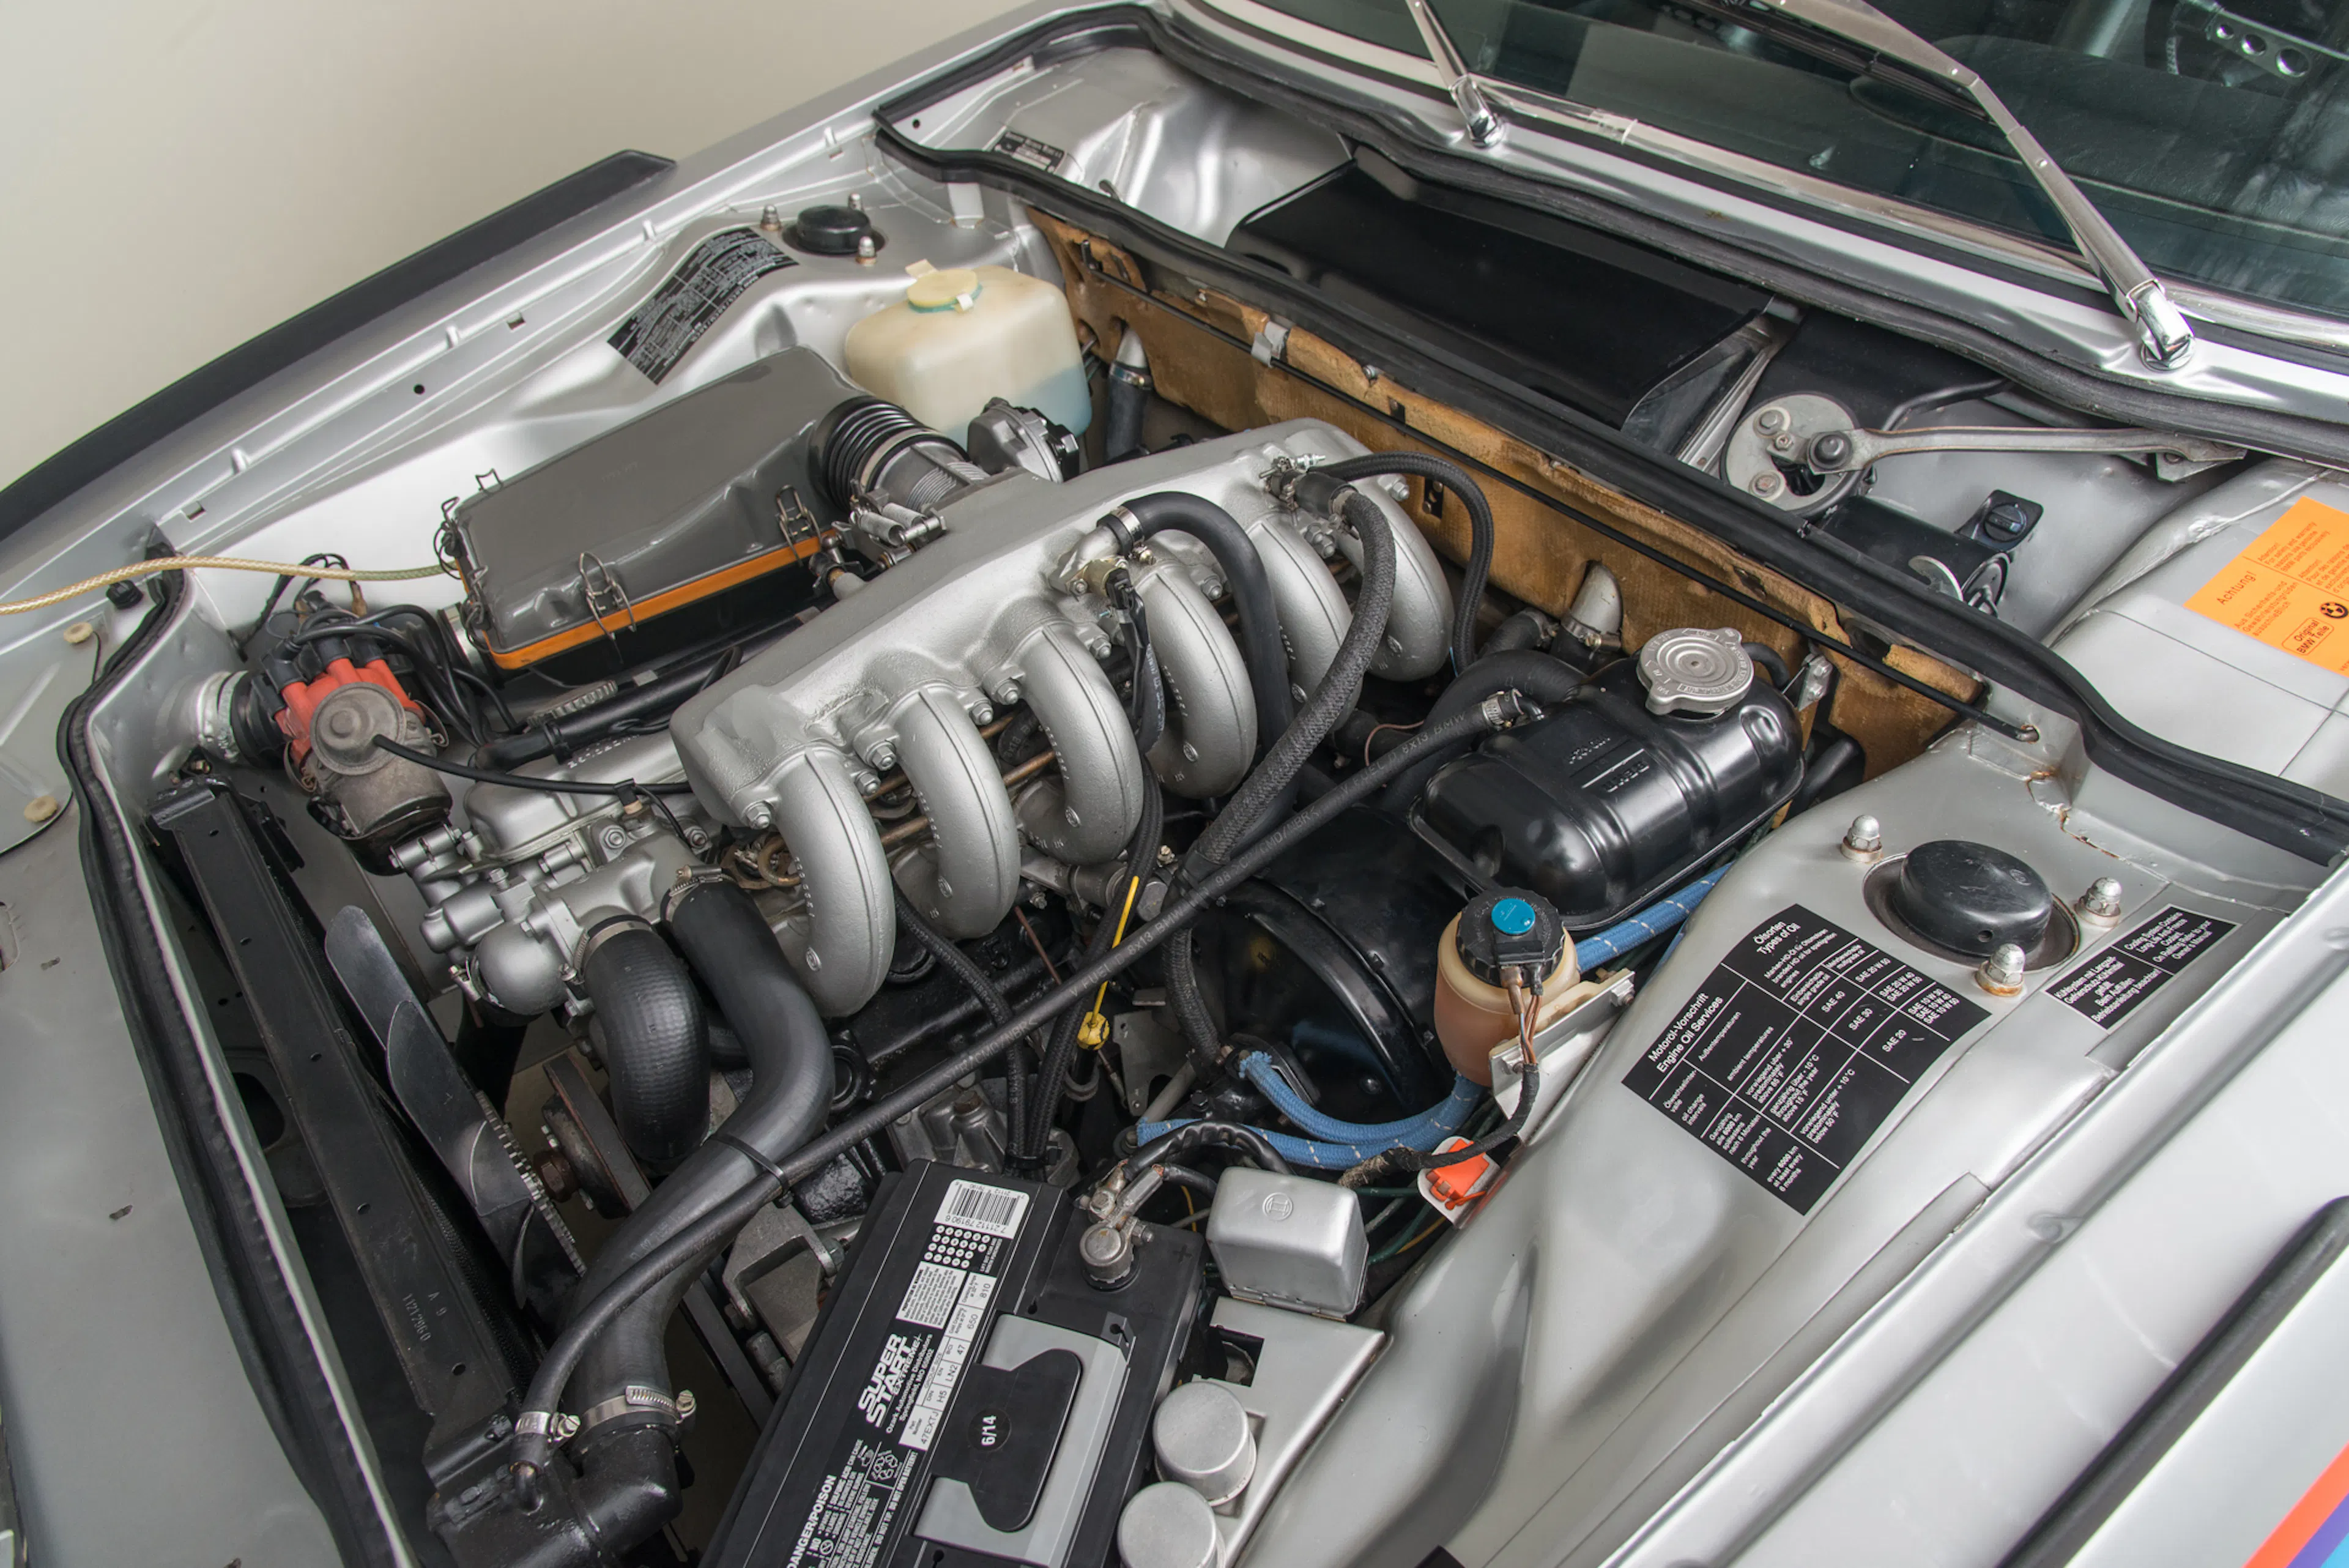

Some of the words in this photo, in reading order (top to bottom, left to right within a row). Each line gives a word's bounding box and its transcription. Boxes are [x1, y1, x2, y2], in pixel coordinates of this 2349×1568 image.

[2216, 570, 2257, 606] Achtung!
[2293, 620, 2319, 641] Original
[2296, 639, 2315, 653] BMW
[2310, 626, 2329, 638] Teile
[1431, 710, 1467, 736] BMW
[1154, 906, 1186, 934] BMW
[1753, 922, 1786, 943] Ölsorten
[1757, 937, 1782, 954] Types
[1786, 923, 1800, 931] Oil
[1772, 964, 1792, 983] branded
[1855, 971, 1871, 982] SAE
[1879, 985, 1894, 997] SAE
[1887, 990, 1902, 1001] SAE
[1912, 975, 1922, 983] 50
[1821, 998, 1838, 1012] SAE
[1908, 1003, 1923, 1014] SAE
[1915, 1007, 1931, 1019] SAE
[1649, 994, 1708, 1061] Motoröl-Vorschrift
[1849, 1016, 1865, 1030] SAE
[1861, 1008, 1872, 1017] 30
[1923, 1012, 1939, 1024] SAE
[1657, 1044, 1683, 1072] Engine
[1680, 1030, 1694, 1044] Oil
[1691, 997, 1723, 1031] Services
[1882, 1036, 1899, 1052] SAE
[1895, 1030, 1906, 1038] 20
[1727, 1059, 1746, 1081] ambient
[1743, 1027, 1773, 1060] temperatures
[1840, 1069, 1855, 1084] 10°C
[1687, 1094, 1704, 1114] change
[1758, 1086, 1773, 1103] above
[1723, 1121, 1735, 1135] 6000
[1732, 1113, 1742, 1122] km
[1767, 1167, 1781, 1182] every
[1778, 1154, 1791, 1168] 6000
[1788, 1146, 1798, 1155] km
[979, 1284, 990, 1298] 810
[967, 1314, 978, 1329] 650
[957, 1344, 965, 1354] 47
[859, 1334, 901, 1412] SUPER
[867, 1337, 914, 1426] START
[945, 1364, 957, 1381] LN2
[886, 1413, 899, 1433] Ozark
[896, 1373, 916, 1411] Automotive
[911, 1334, 932, 1372] Distributors
[899, 1383, 920, 1421] Springfield,
[916, 1369, 925, 1381] MO
[937, 1391, 947, 1403] H5
[912, 1418, 922, 1435] Number
[921, 1411, 938, 1444] 47EXTJ
[981, 1416, 996, 1445] 6/14
[841, 1465, 852, 1479] ACID
[847, 1455, 856, 1465] CAN
[897, 1476, 907, 1490] OPEN
[888, 1501, 897, 1510] DO
[892, 1490, 901, 1501] NOT
[878, 1522, 888, 1534] NOT
[809, 1538, 822, 1550] NO
[875, 1534, 884, 1544] DO
